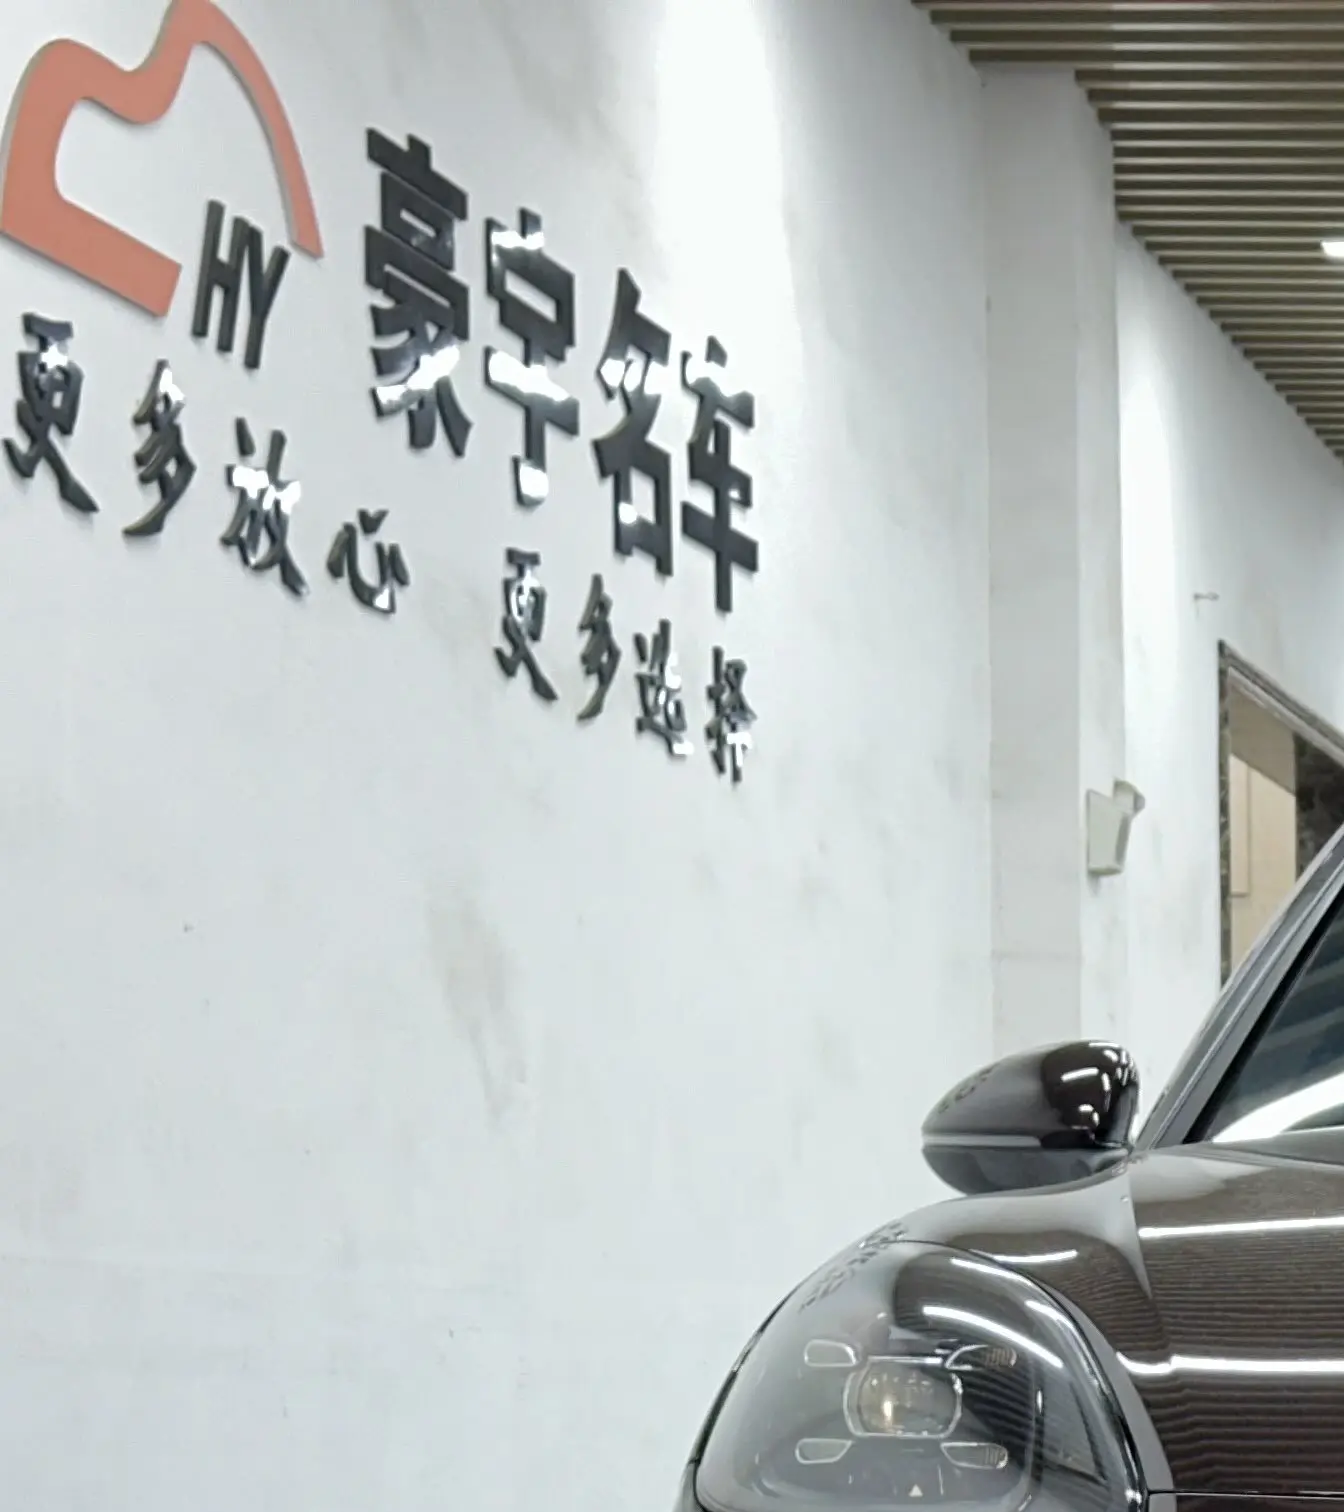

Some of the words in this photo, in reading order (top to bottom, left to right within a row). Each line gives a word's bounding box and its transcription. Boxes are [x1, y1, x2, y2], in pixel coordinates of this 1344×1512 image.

[191, 199, 290, 369] HY
[364, 128, 758, 613] 豪宇名车
[2, 311, 410, 614] 更多放心
[493, 546, 758, 784] 更多选择
